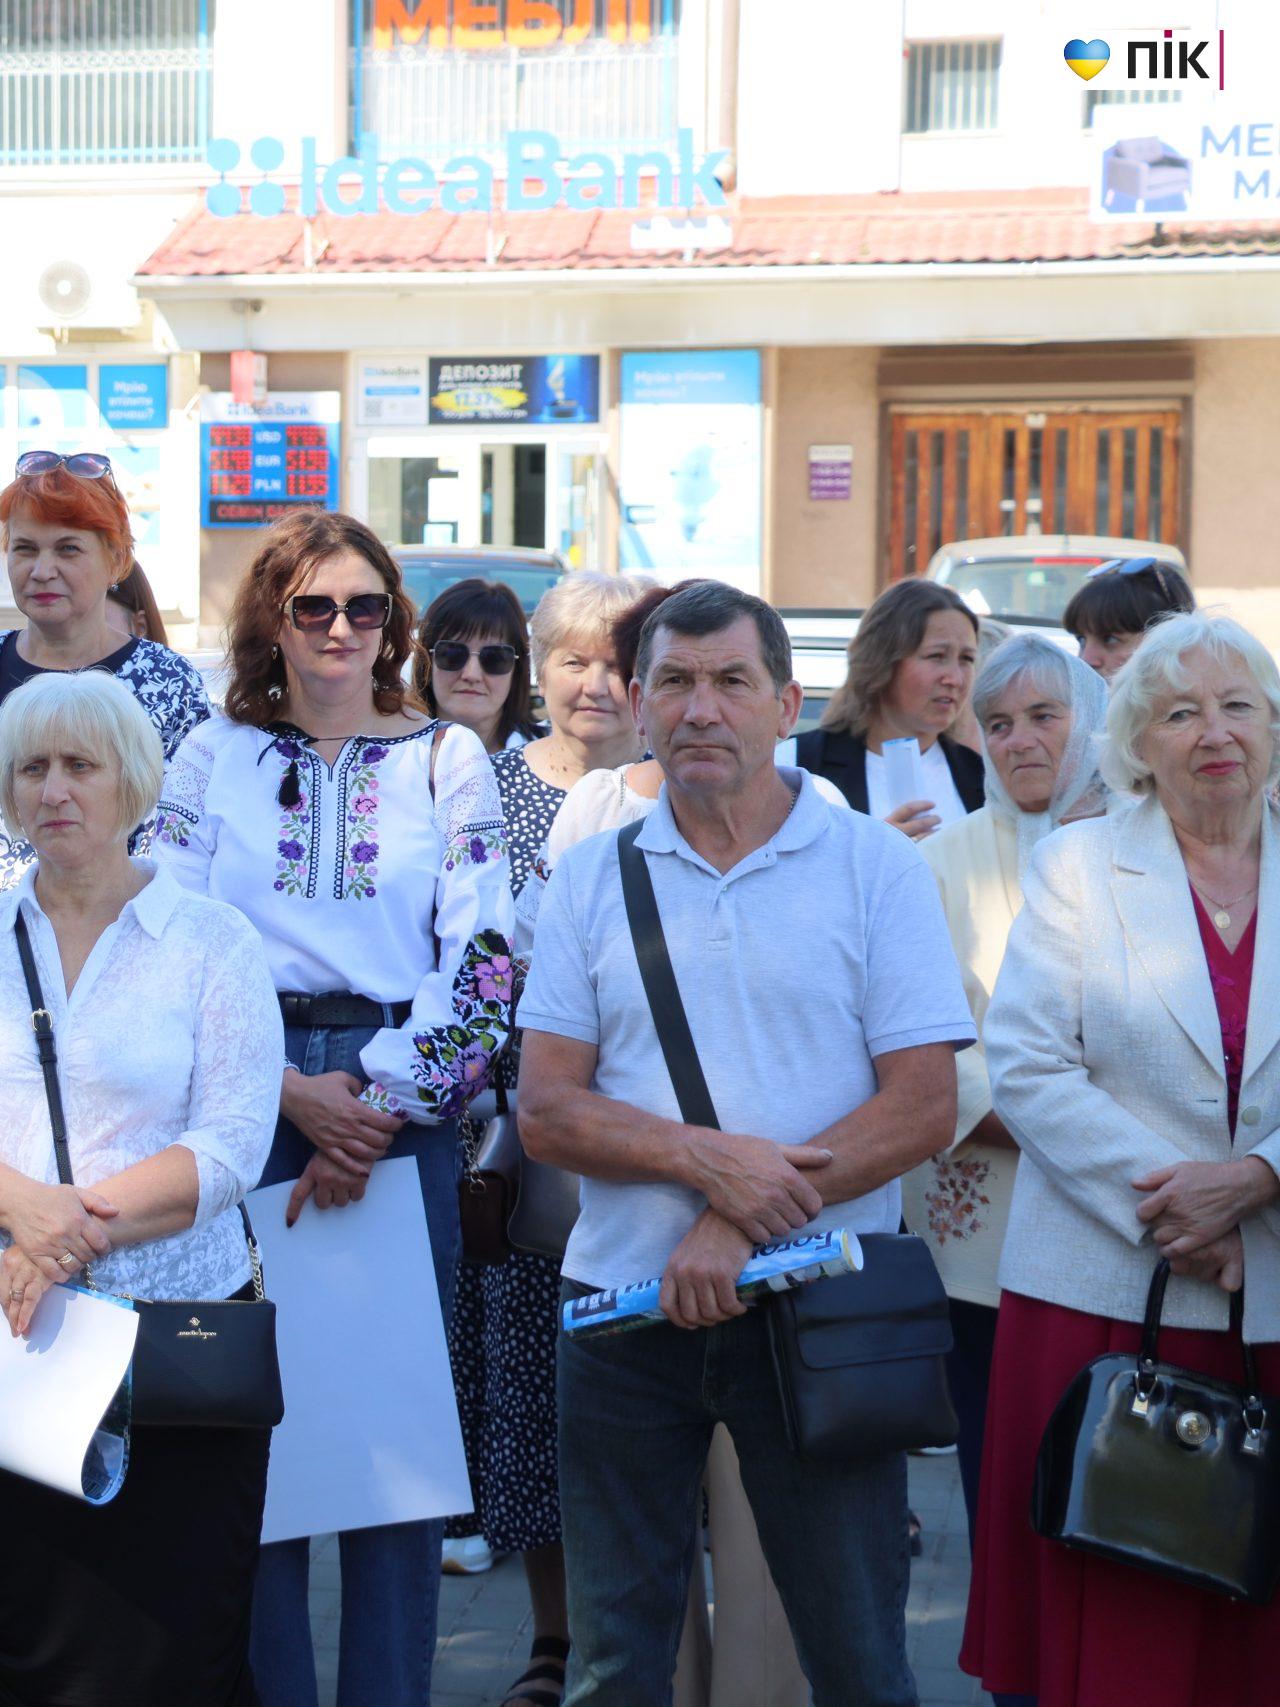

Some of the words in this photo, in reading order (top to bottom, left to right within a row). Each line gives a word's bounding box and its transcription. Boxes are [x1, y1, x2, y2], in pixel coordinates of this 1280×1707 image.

[1200, 122, 1280, 159] МЕ
[439, 363, 523, 382] ДЕПОЗИТ
[255, 431, 281, 443] USD
[255, 454, 282, 467] EUR
[254, 479, 282, 491] PLN
